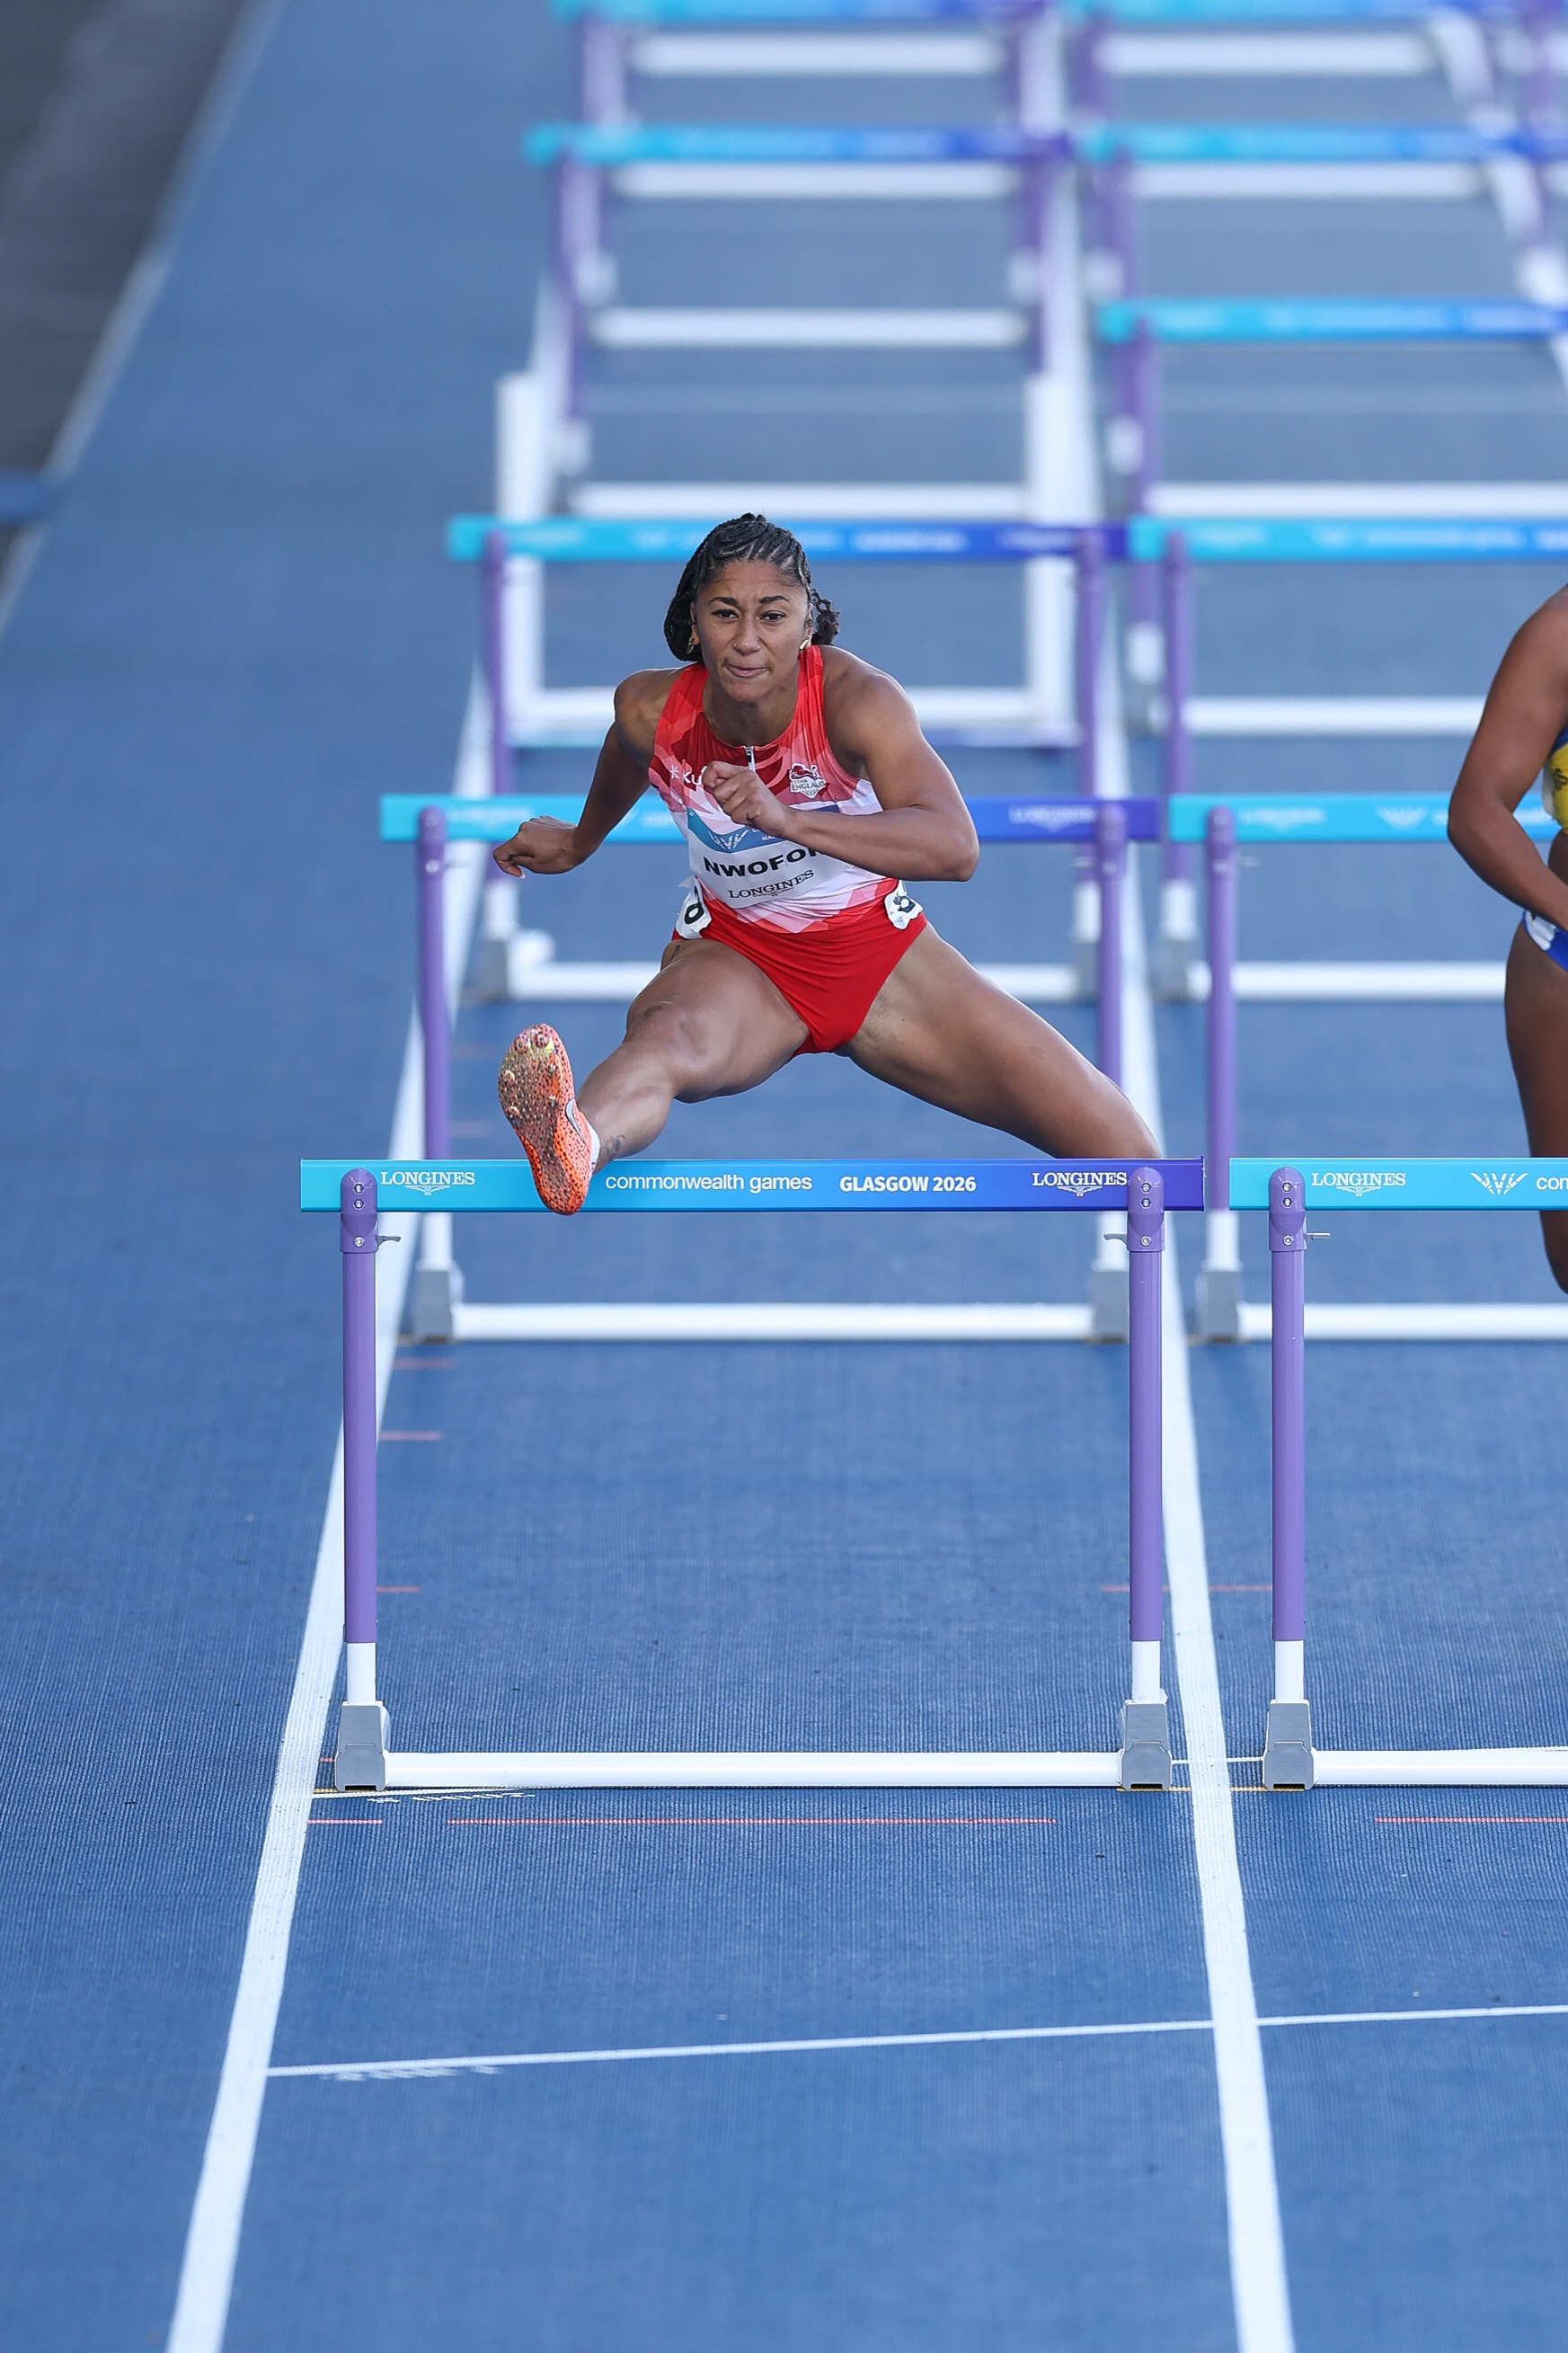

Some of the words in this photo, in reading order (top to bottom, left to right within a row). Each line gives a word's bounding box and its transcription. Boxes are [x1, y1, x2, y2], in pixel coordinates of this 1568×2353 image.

[728, 869, 814, 899] LONGINES
[380, 1171, 475, 1185] LONGINES
[605, 1174, 745, 1191] commonwealth
[749, 1176, 812, 1195] games
[839, 1176, 928, 1193] GLASGOW
[933, 1176, 977, 1193] 2026
[1032, 1171, 1128, 1186] LONGINES
[1310, 1172, 1406, 1186] LONGINES
